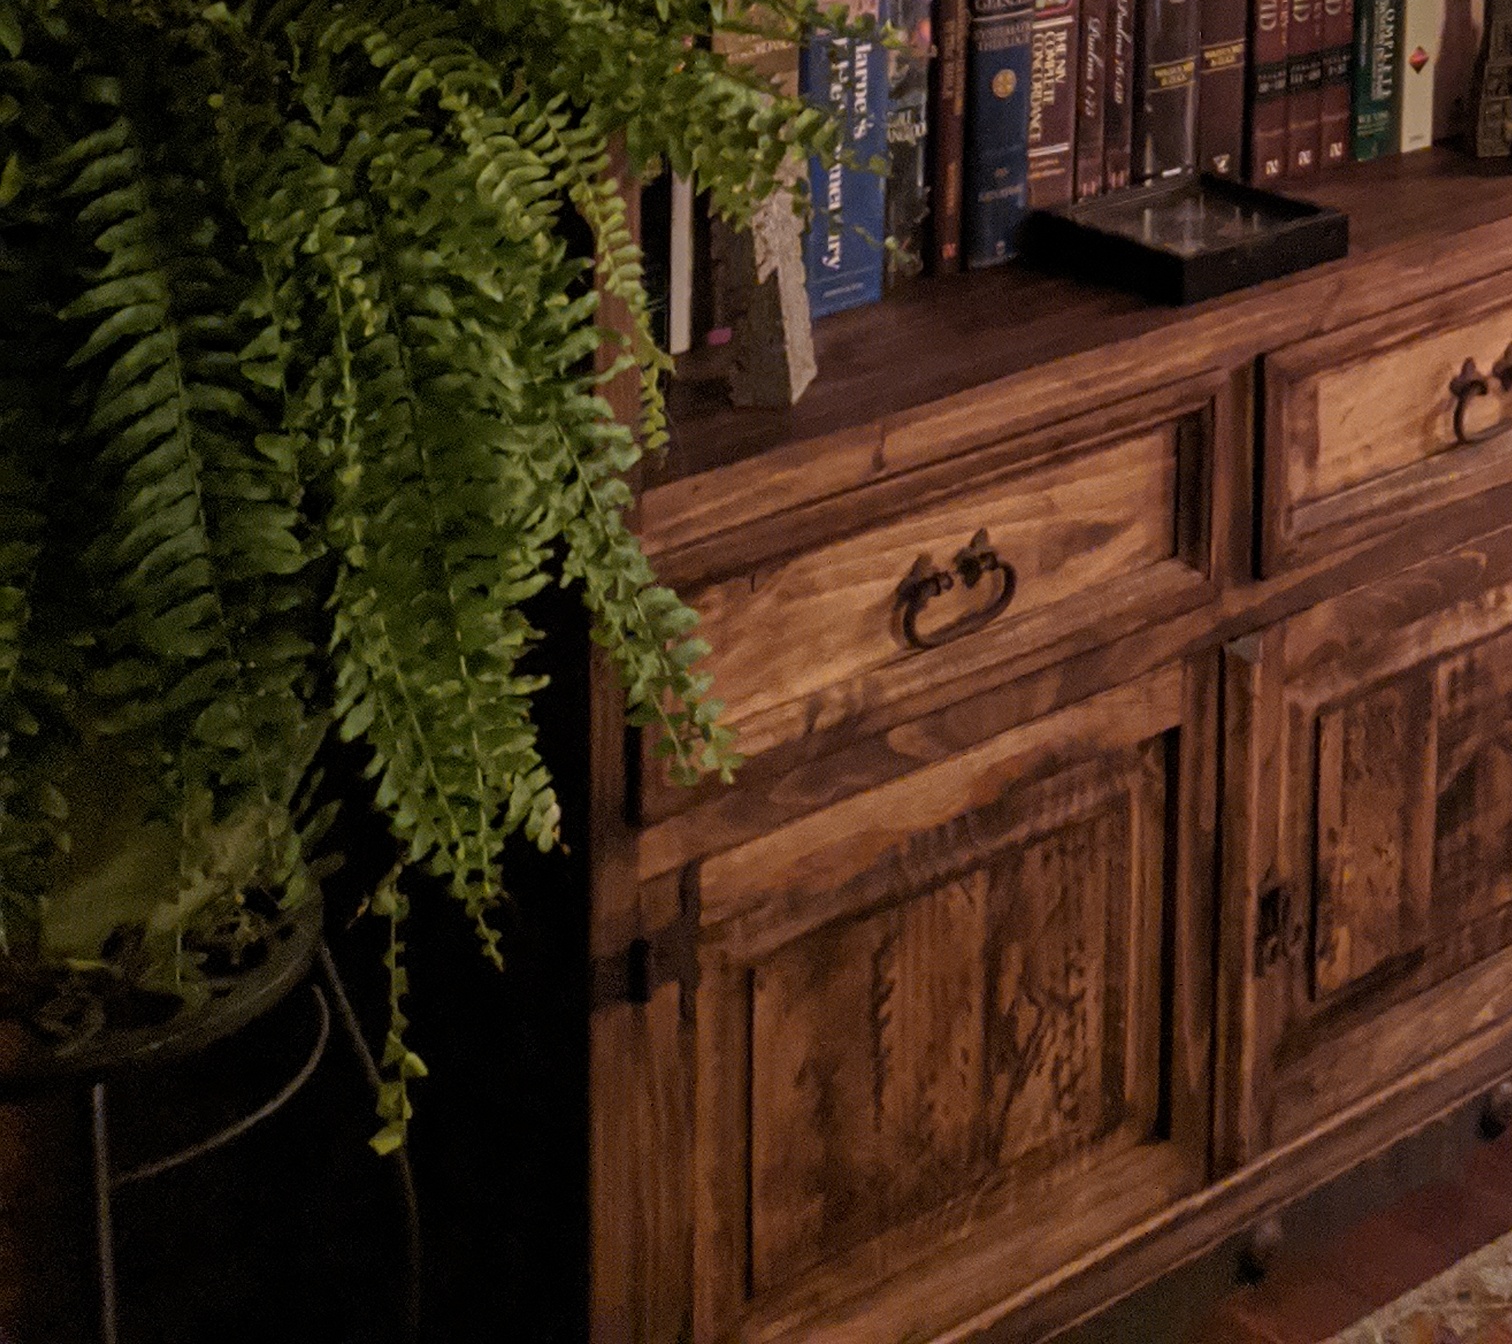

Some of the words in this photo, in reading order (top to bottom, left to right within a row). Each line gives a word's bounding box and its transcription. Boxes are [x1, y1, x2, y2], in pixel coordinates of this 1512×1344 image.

[1043, 30, 1056, 106] COMPLETE
[1055, 60, 1067, 84] NIV
[1056, 29, 1068, 59] THE
[1085, 15, 1104, 80] Psalms
[1028, 32, 1045, 144] CONCORDANCE
